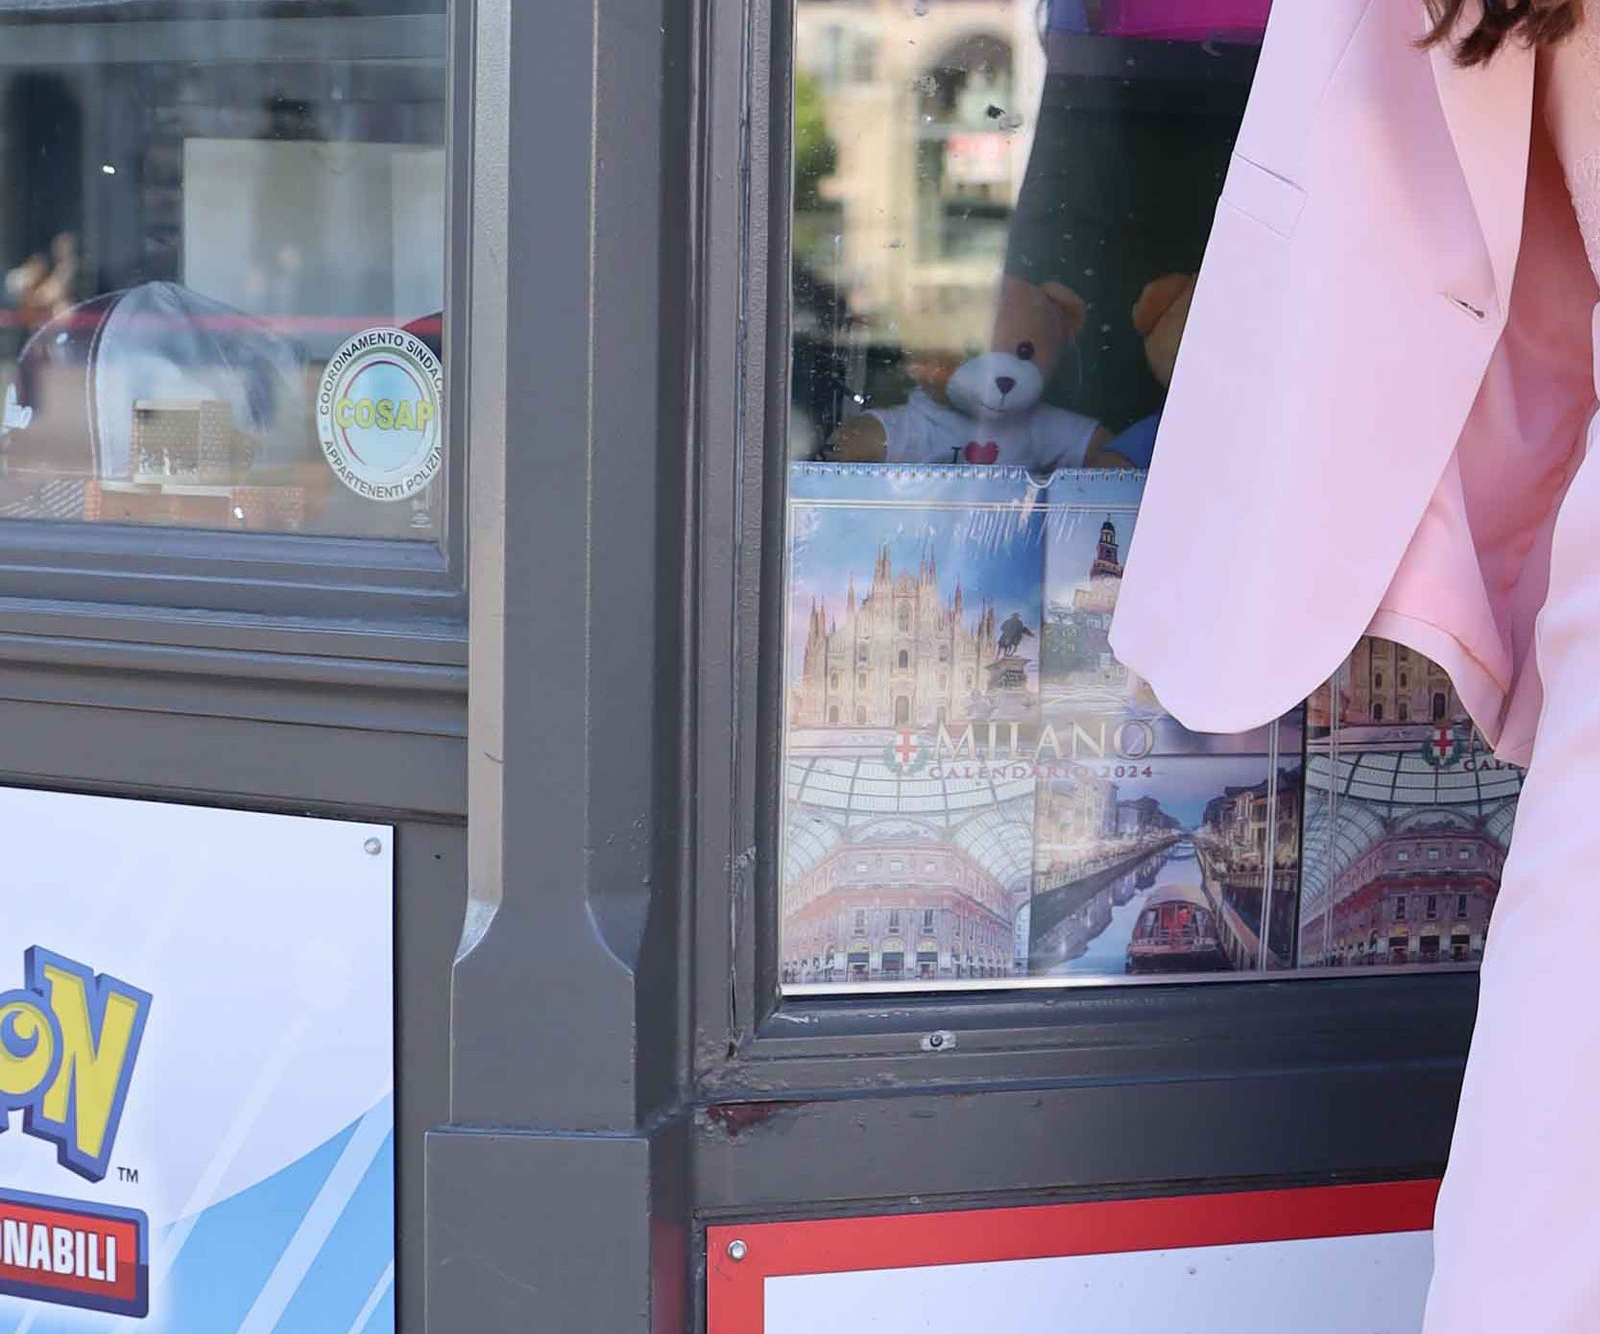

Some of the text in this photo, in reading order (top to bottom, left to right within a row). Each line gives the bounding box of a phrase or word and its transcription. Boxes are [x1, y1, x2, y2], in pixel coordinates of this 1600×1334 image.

[319, 331, 444, 416] COORDINAMENTO SINDAC
[335, 397, 434, 432] COSAP
[323, 440, 405, 500] APPARTENENTI
[934, 718, 1155, 761] MILANO
[1098, 763, 1154, 780] 2024
[117, 1166, 139, 1185] TM
[0, 1218, 117, 1283] NABILI
